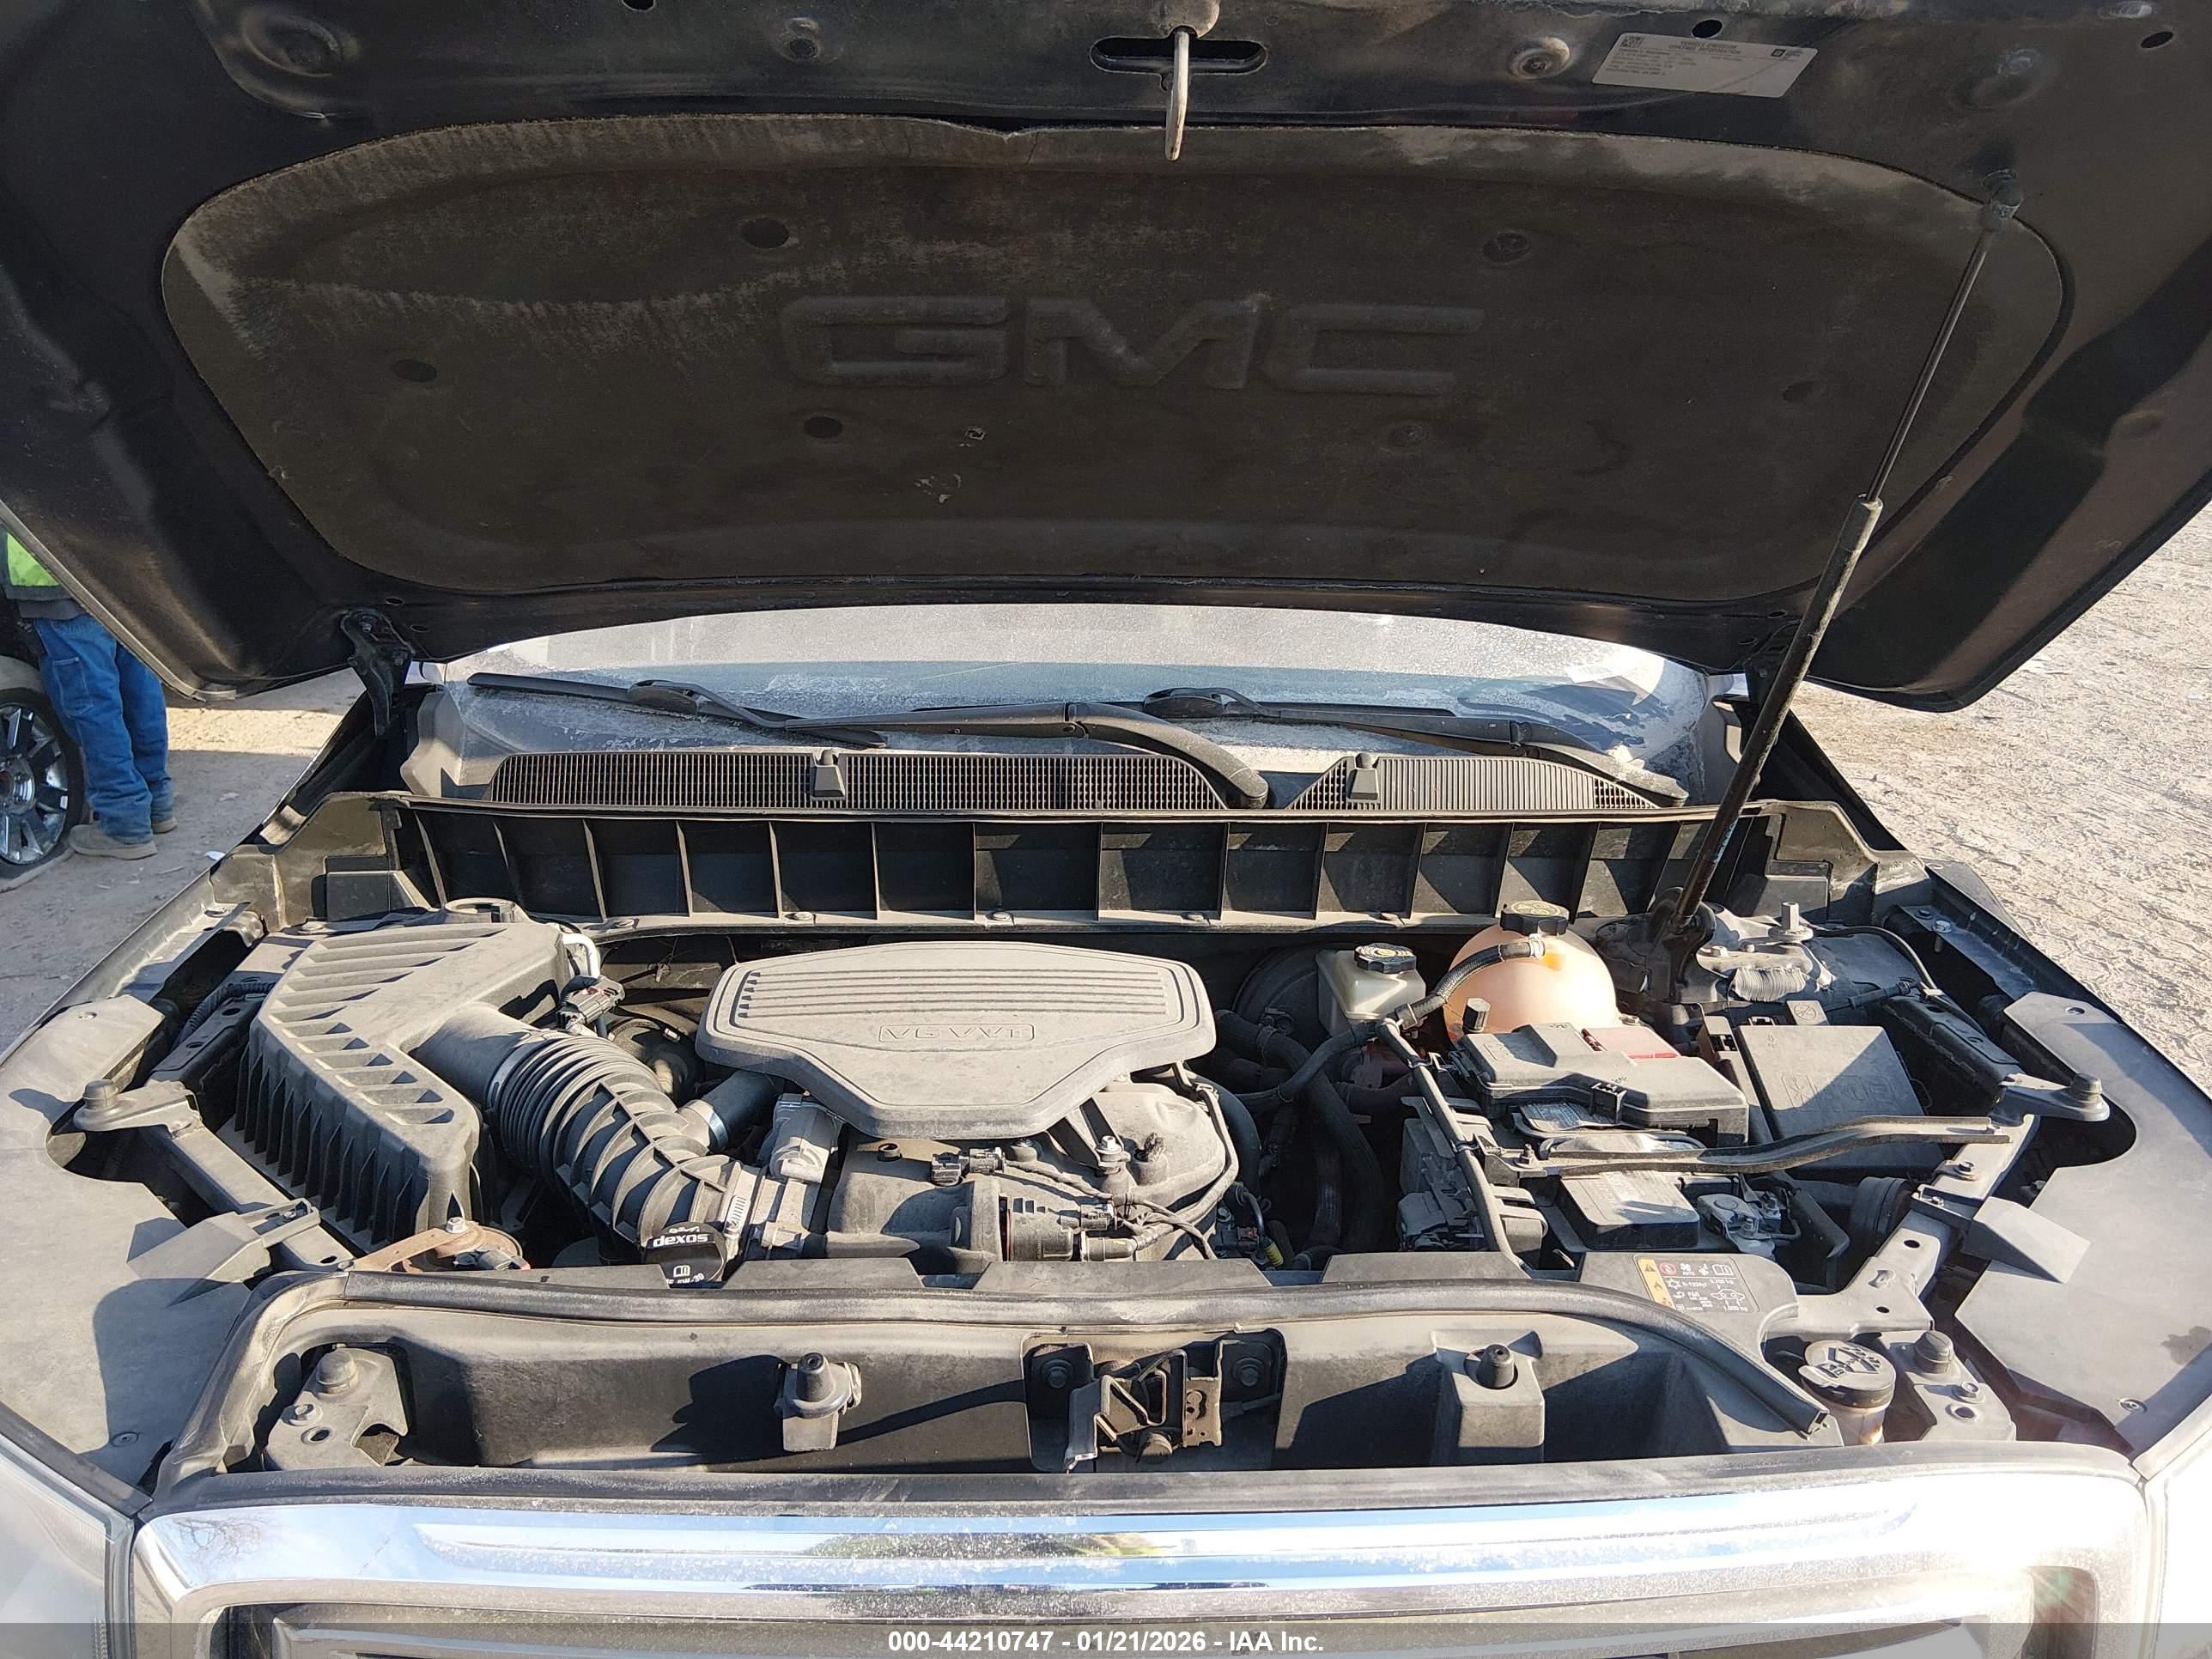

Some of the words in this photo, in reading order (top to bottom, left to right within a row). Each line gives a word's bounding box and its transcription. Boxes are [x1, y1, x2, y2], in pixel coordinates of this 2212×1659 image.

[781, 293, 1486, 395] GMC
[885, 1027, 942, 1039] V6
[653, 1234, 708, 1248] dexos
